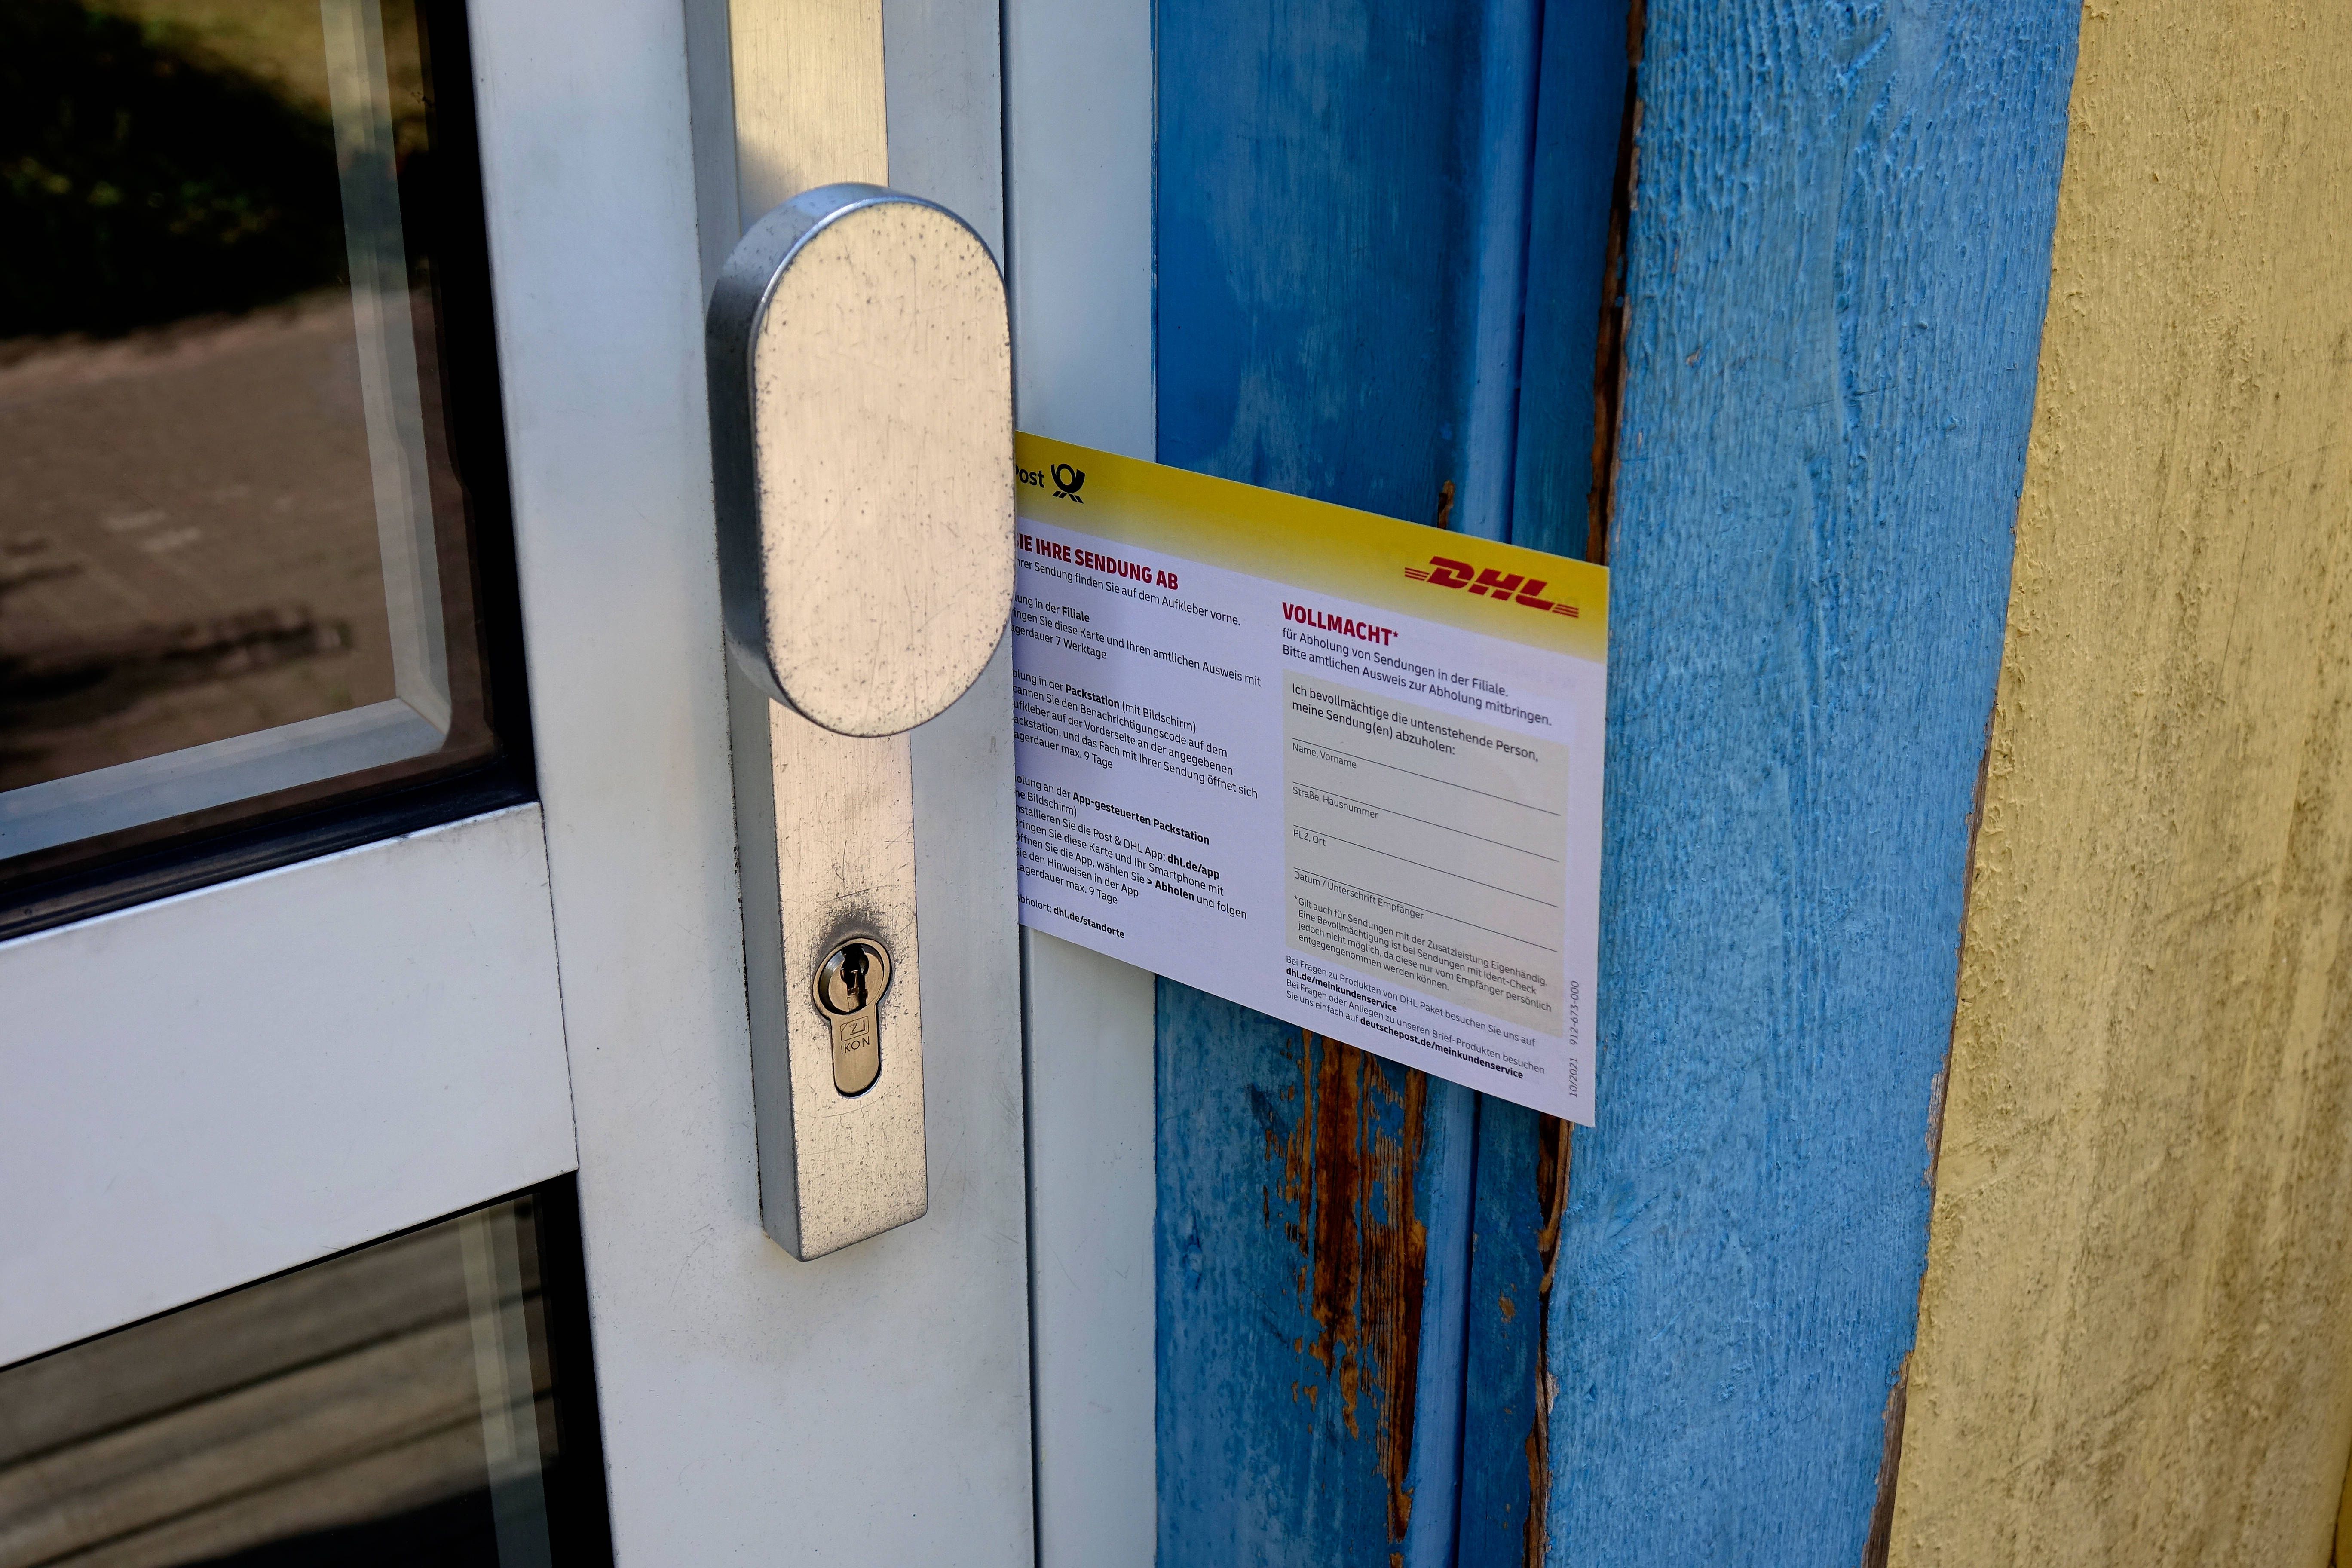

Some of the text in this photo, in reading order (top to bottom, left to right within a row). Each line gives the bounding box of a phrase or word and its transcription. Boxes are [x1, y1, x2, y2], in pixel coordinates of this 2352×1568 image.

[1017, 533, 1178, 590] IE IHRE SENDUNG AB
[1427, 556, 1555, 611] DHL
[1034, 561, 1240, 626] Sendung finden Sie auf dem Aufkleber vorne.
[1045, 601, 1090, 623] der Filiale
[1039, 615, 1261, 687] Sie diese Karte und Ihren amtlichen Ausweis mit
[1063, 637, 1107, 660] Werktage
[1282, 627, 1508, 697] für Abholung von Sendungen der Filiale.
[1049, 679, 1063, 692] der
[1066, 683, 1120, 709] Packstation
[1122, 700, 1141, 716] (mit
[1143, 707, 1196, 734] Bildschirm)
[1283, 644, 1552, 726] Bitte amtlichen Ausweis zur Abholung mitbringen.
[1046, 693, 1060, 706] Sie
[1061, 698, 1078, 712] den
[1080, 703, 1186, 745] Benachrichtigungscode
[1188, 739, 1204, 750] auf
[1206, 742, 1227, 758] dem
[1051, 712, 1066, 723] auf
[1068, 715, 1083, 728] der
[1084, 720, 1136, 745] Vorderseite
[1151, 741, 1167, 754] der
[1168, 748, 1233, 775] angegebenen
[1292, 683, 1538, 762] Ich bevollmächtige die untenstehende Person,
[1292, 701, 1455, 755] meine Sendung(en) abzuholen:
[1061, 745, 1082, 759] max.
[1091, 753, 1113, 769] Tage
[1063, 730, 1080, 743] und
[1081, 735, 1097, 748] das
[1099, 740, 1120, 756] Fach
[1122, 749, 1137, 762] mit
[1139, 753, 1161, 769] Ihrer
[1163, 761, 1205, 785] Sendung
[1207, 774, 1237, 793] öffnet
[1238, 785, 1257, 799] sich
[1292, 742, 1357, 769] Name, Vorname
[1027, 792, 1077, 818] Bildschirm)
[1056, 786, 1210, 845] der App-gesteuerten Packstation
[1293, 786, 1379, 819] Straße, Hausnummer
[1048, 828, 1224, 896] Sie diese Karte und Ihr Smartphone mit
[1063, 818, 1220, 881] Sie die Post DHL App: dhl.de/app
[1293, 829, 1326, 847] PLZ, Ort
[1029, 851, 1139, 898] den Hinweisen der App
[1045, 842, 1246, 919] Sie die App, wählen Sie Abholen und folgen
[1066, 879, 1118, 904] max. Tage
[1294, 870, 1424, 919] Datum Unterschrift Empfänger
[1054, 906, 1125, 939] dhl.de/standorte
[1298, 909, 1537, 995] Eine Bevollmächtigung Sendungen Ident-Check
[1313, 903, 1332, 916] auch
[1347, 913, 1394, 936] Sendungen
[1427, 939, 1489, 969] Zusatzleistung
[1491, 960, 1548, 987] Eigenhändig.
[1286, 967, 1397, 1013] dhl.de/meinkundenservice
[1298, 934, 1449, 991] entgegengenommen werden können.
[1298, 920, 1552, 1012] jedoch nicht möglich, Empfänger persönlich
[1286, 955, 1486, 1031] Bei Fragen Produkten DHL Paket besuchen
[841, 1036, 870, 1055] IKON
[1300, 983, 1545, 1074] Fragen Anliegen unseren Brief-Produkten besuchen
[1315, 1001, 1524, 1079] einfach deutschepost.de/meinkundenservice
[1569, 980, 1579, 1098] 10/2021 912-673-000
